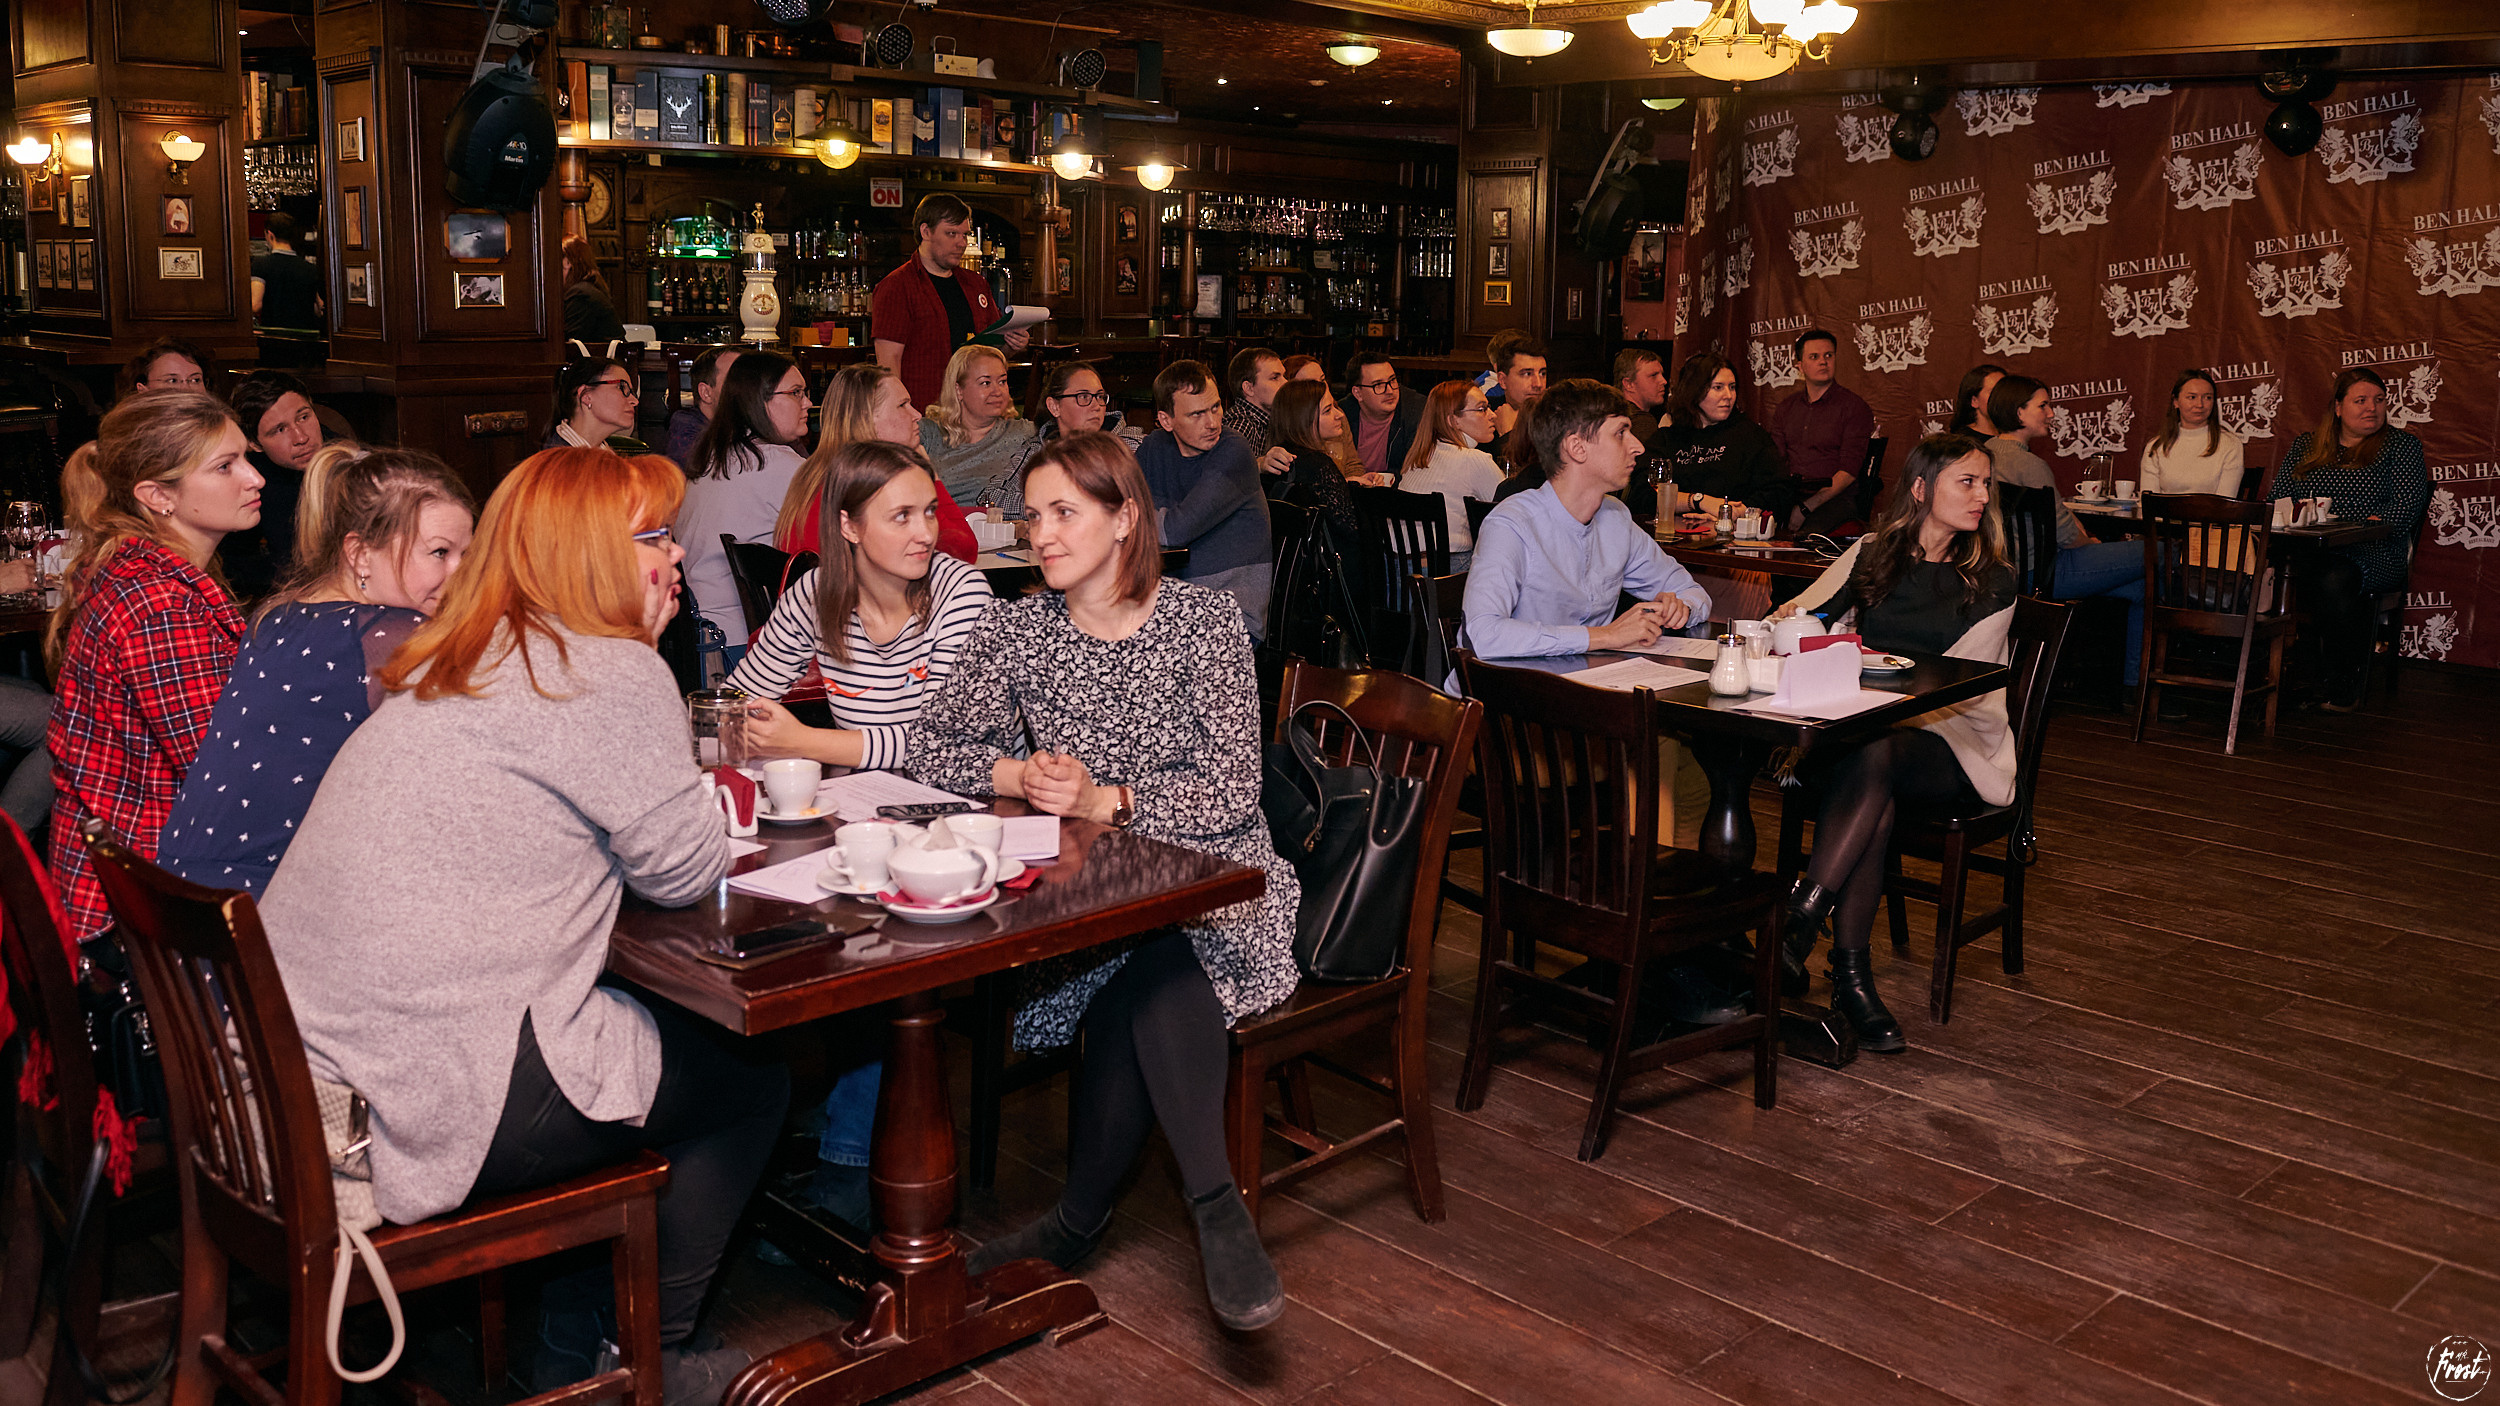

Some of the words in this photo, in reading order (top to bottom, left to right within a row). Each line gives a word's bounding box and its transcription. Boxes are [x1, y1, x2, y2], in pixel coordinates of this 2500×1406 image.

[2322, 100, 2358, 120] BEN
[2363, 90, 2415, 112] HALL
[1758, 109, 1793, 128] HALL
[2171, 130, 2204, 149] BEN
[2209, 121, 2256, 142] HALL
[504, 155, 524, 164] Martin
[2034, 157, 2062, 177] BEN
[2067, 149, 2111, 170] HALL
[873, 188, 900, 204] ON
[1910, 184, 1936, 201] BEN
[1940, 176, 1980, 195] HALL
[1794, 208, 1819, 224] BEN
[1823, 201, 1859, 219] HALL
[2413, 210, 2450, 230] BEN
[2456, 203, 2500, 224] HAL
[2255, 237, 2289, 255] BEN
[2294, 229, 2343, 249] HALL
[2108, 260, 2140, 277] BEN
[2145, 252, 2190, 271] HALL
[1980, 281, 2007, 298] BEN
[2011, 275, 2051, 293] HALL
[1860, 301, 1885, 317] BEN
[1889, 295, 1927, 312] HALL
[1750, 320, 1773, 334] BEN
[1777, 314, 1812, 330] HALL
[2341, 348, 2377, 365] BEN
[2383, 342, 2434, 360] HALL
[2227, 360, 2275, 379] HALL
[2051, 383, 2081, 399] BEN
[2085, 378, 2127, 395] HALL
[1926, 400, 1954, 414] BEN
[2431, 464, 2469, 480] BEN
[2475, 462, 2500, 477] HA
